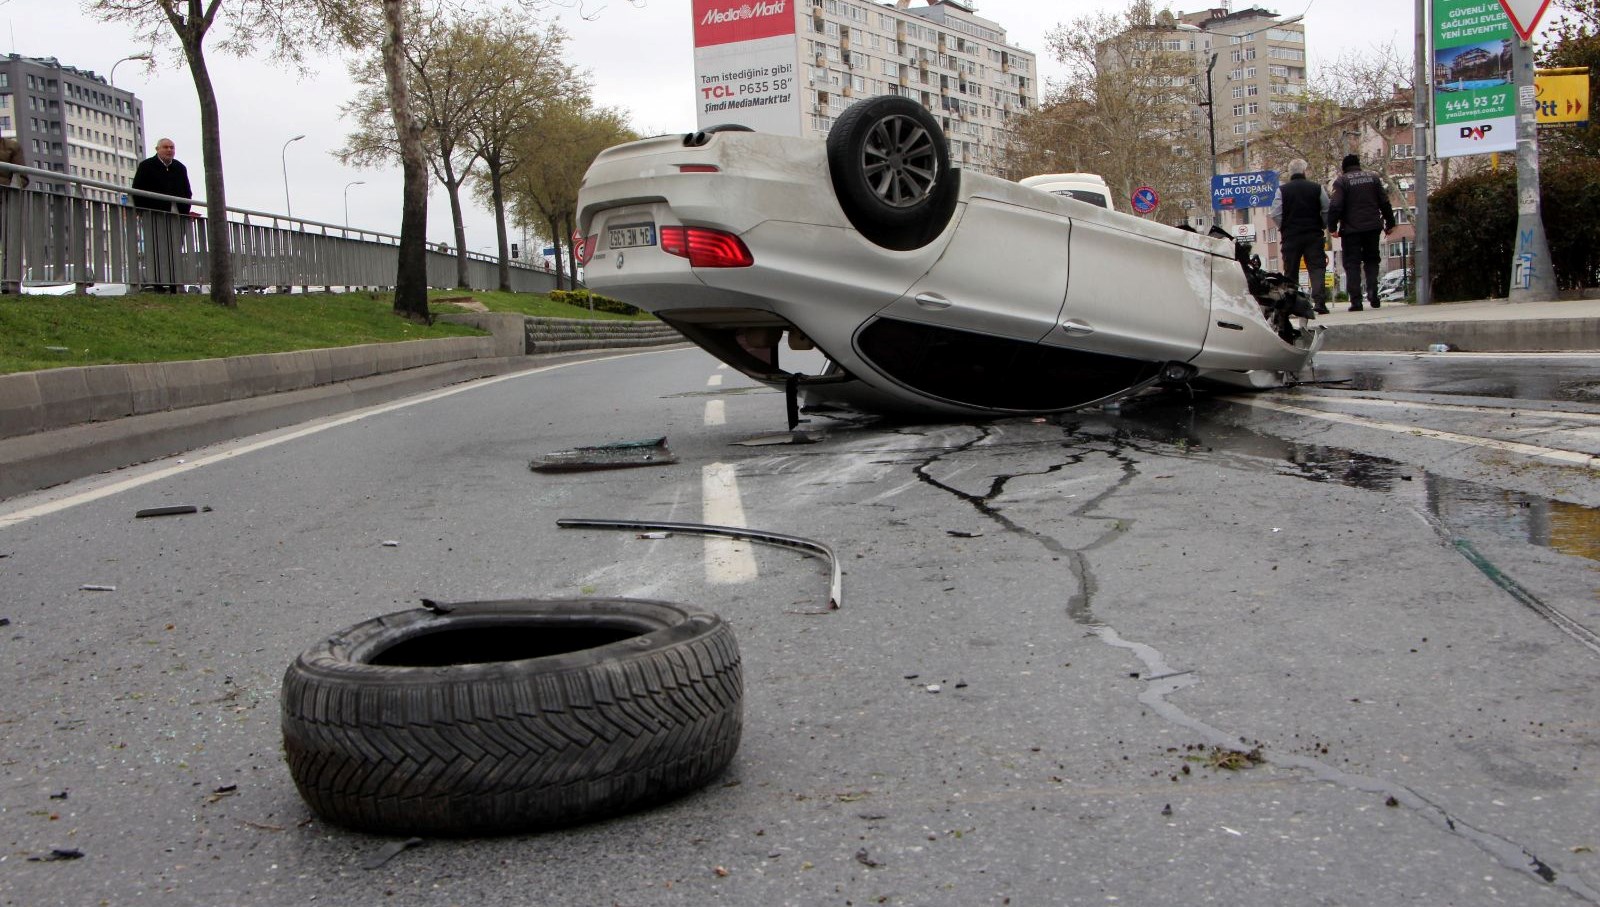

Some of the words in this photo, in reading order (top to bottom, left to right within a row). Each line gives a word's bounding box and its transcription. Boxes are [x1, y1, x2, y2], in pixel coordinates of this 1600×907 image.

[1449, 4, 1486, 18] GÜVENLİ
[1488, 3, 1499, 11] VE
[1441, 17, 1478, 30] SAĞLIKLI
[1441, 28, 1460, 40] YENİ
[1462, 22, 1508, 36] LEVENT'TE
[701, 75, 720, 84] Tam
[722, 68, 769, 82] istediğiniz
[771, 63, 792, 77] gibi!
[701, 85, 734, 99] TCL
[739, 81, 769, 95] P635
[704, 101, 727, 115] Şimdi
[728, 94, 791, 109] MediaMarkt'ta!
[1445, 98, 1469, 111] 444
[1473, 96, 1488, 108] 93
[1492, 93, 1506, 106] 27
[1446, 106, 1504, 119] yenilevent.com.tr
[1223, 175, 1263, 186] PERPA
[1213, 187, 1233, 197] AÇIK
[1234, 184, 1273, 195] OTOPARK
[627, 229, 637, 245] NE
[640, 228, 649, 244] 34
